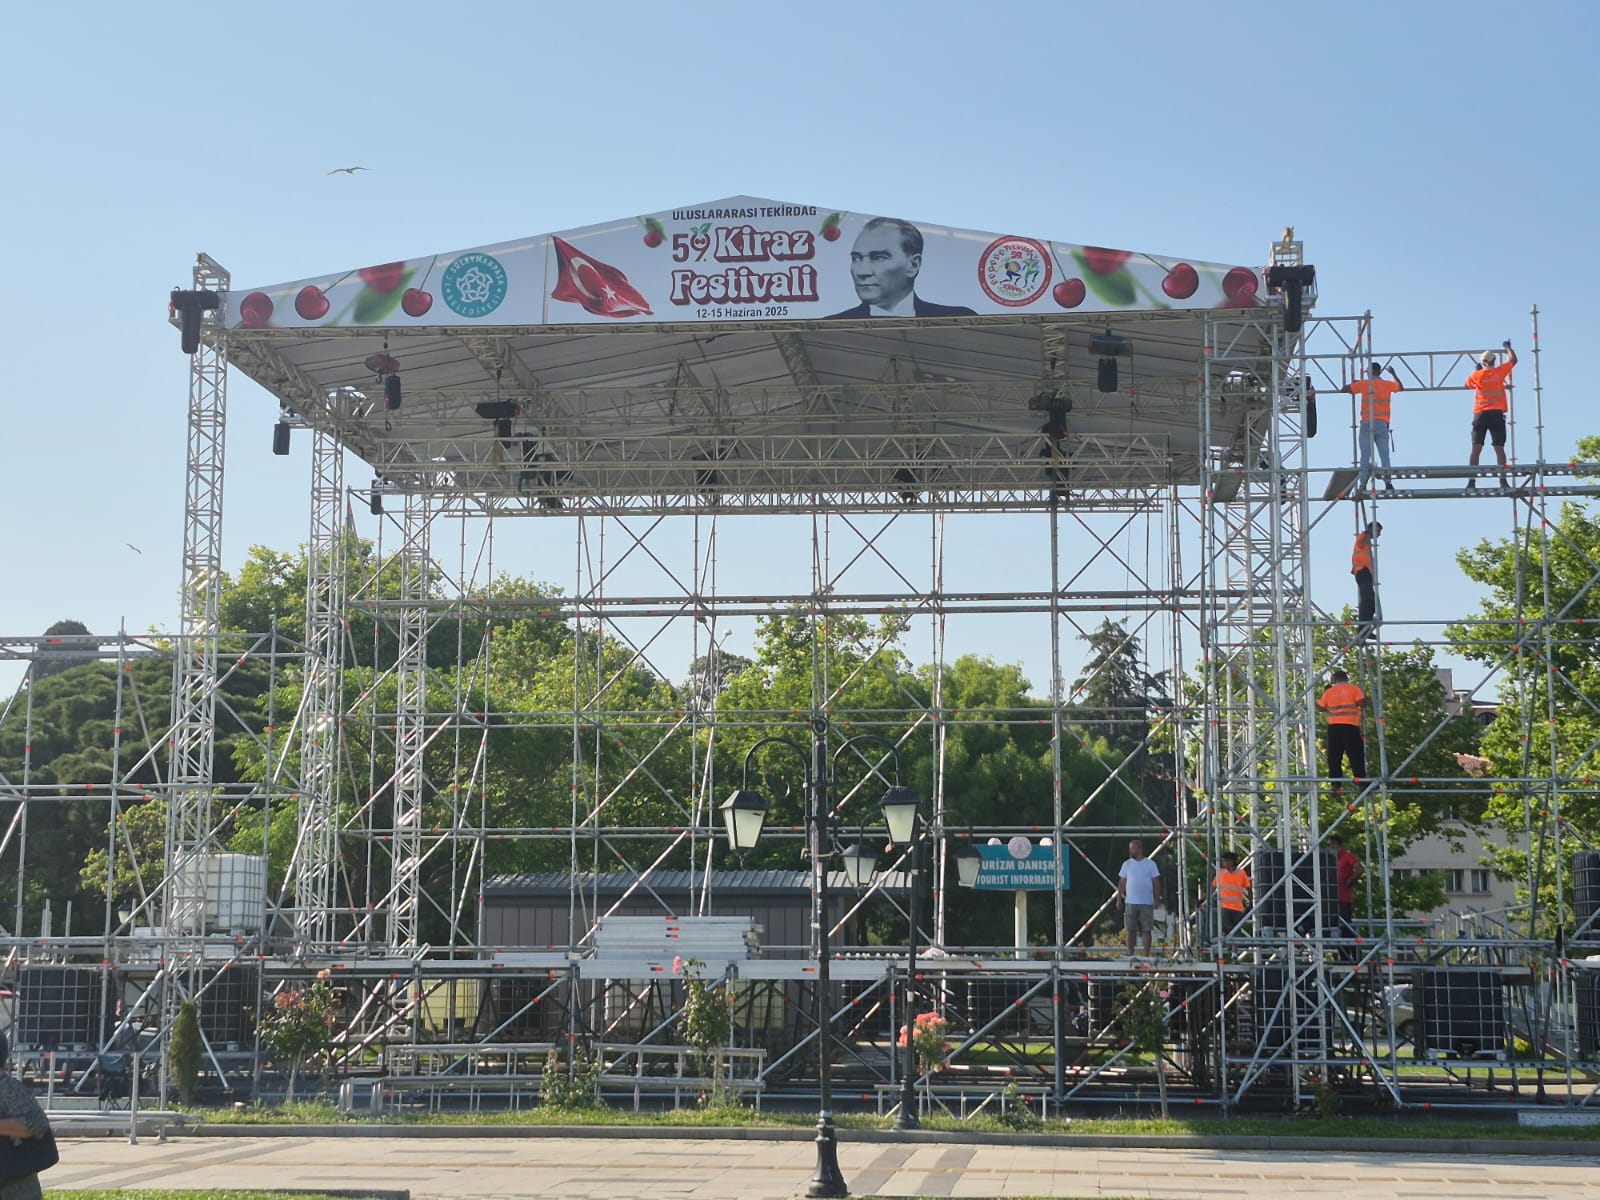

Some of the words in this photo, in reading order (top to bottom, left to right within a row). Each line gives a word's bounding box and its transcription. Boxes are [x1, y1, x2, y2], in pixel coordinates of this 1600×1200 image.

[673, 209, 758, 220] ULUSLARARASI
[714, 225, 815, 262] Kiraz
[670, 264, 819, 304] Festivali
[696, 309, 722, 318] 12-15
[725, 309, 762, 318] Haziran
[765, 307, 788, 316] 2025
[982, 858, 1015, 870] URİZM
